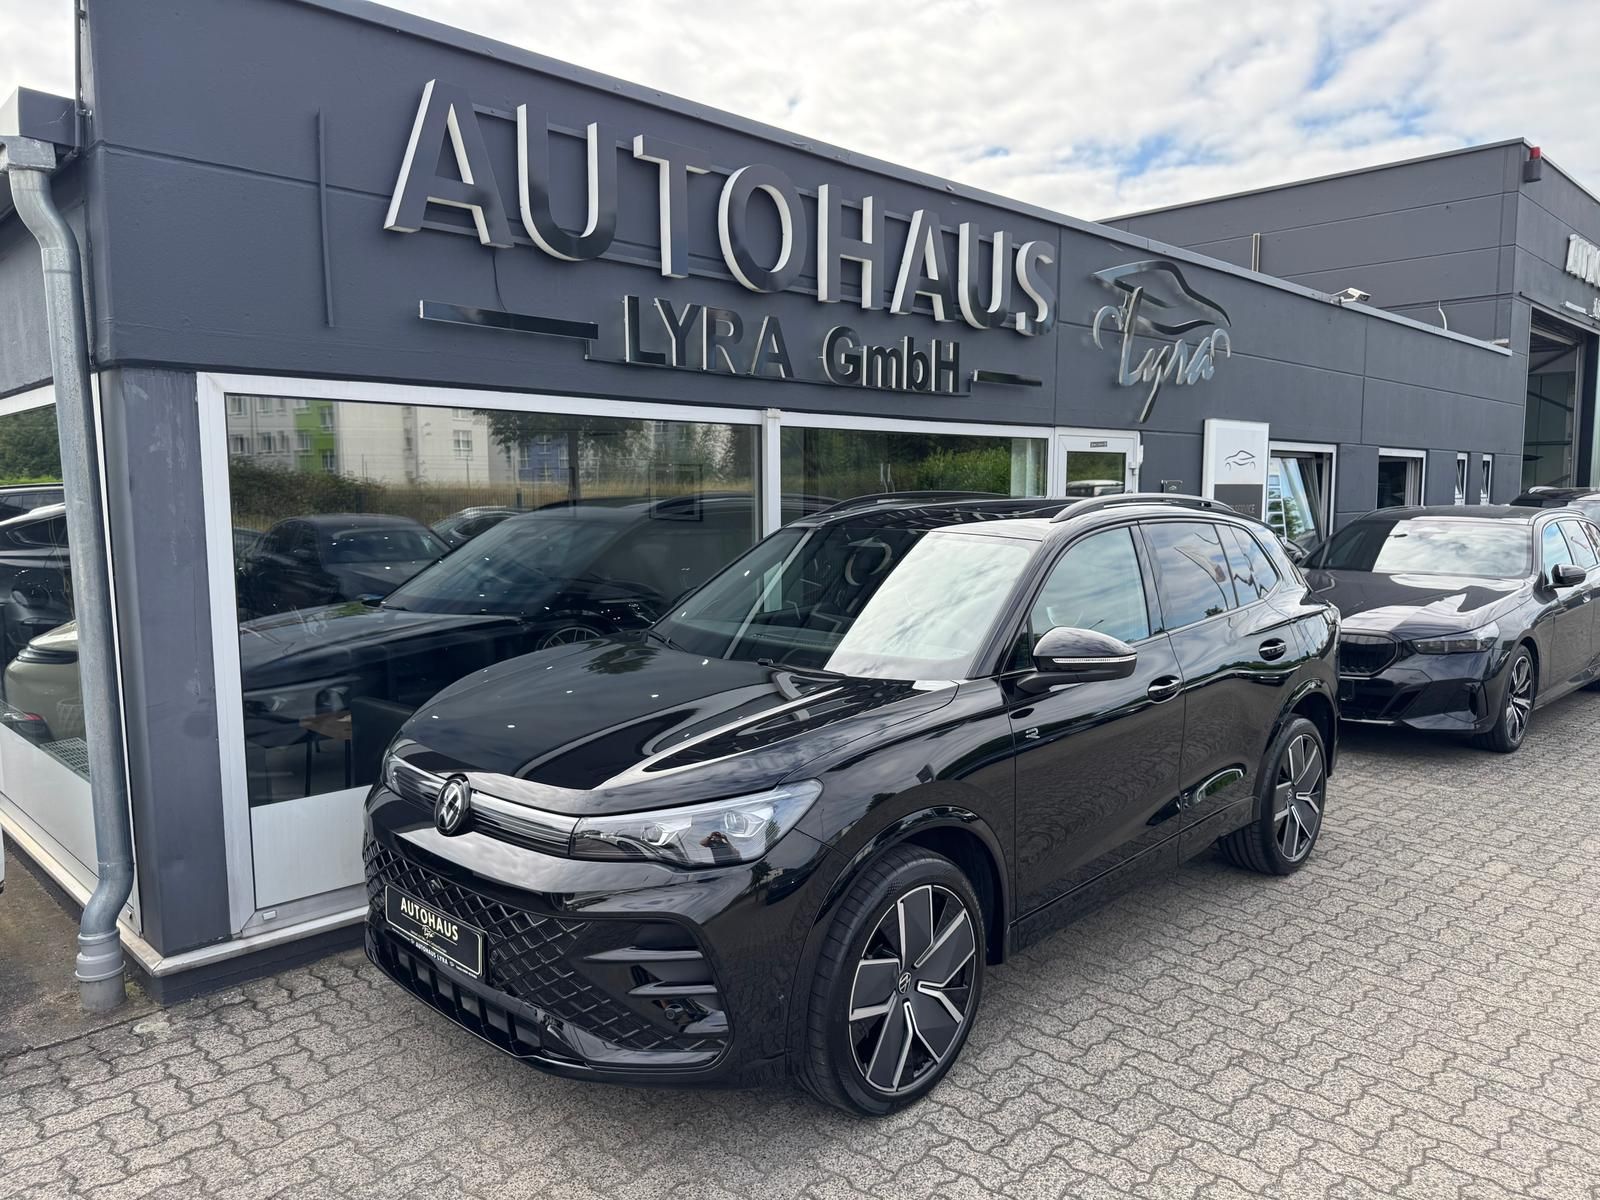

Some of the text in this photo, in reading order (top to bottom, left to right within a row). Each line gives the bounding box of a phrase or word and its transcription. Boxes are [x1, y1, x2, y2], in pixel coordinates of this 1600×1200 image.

[383, 78, 1059, 337] AUTOHAUS
[623, 295, 961, 393] LYRA GmbH
[401, 897, 459, 941] AUTOHAUS
